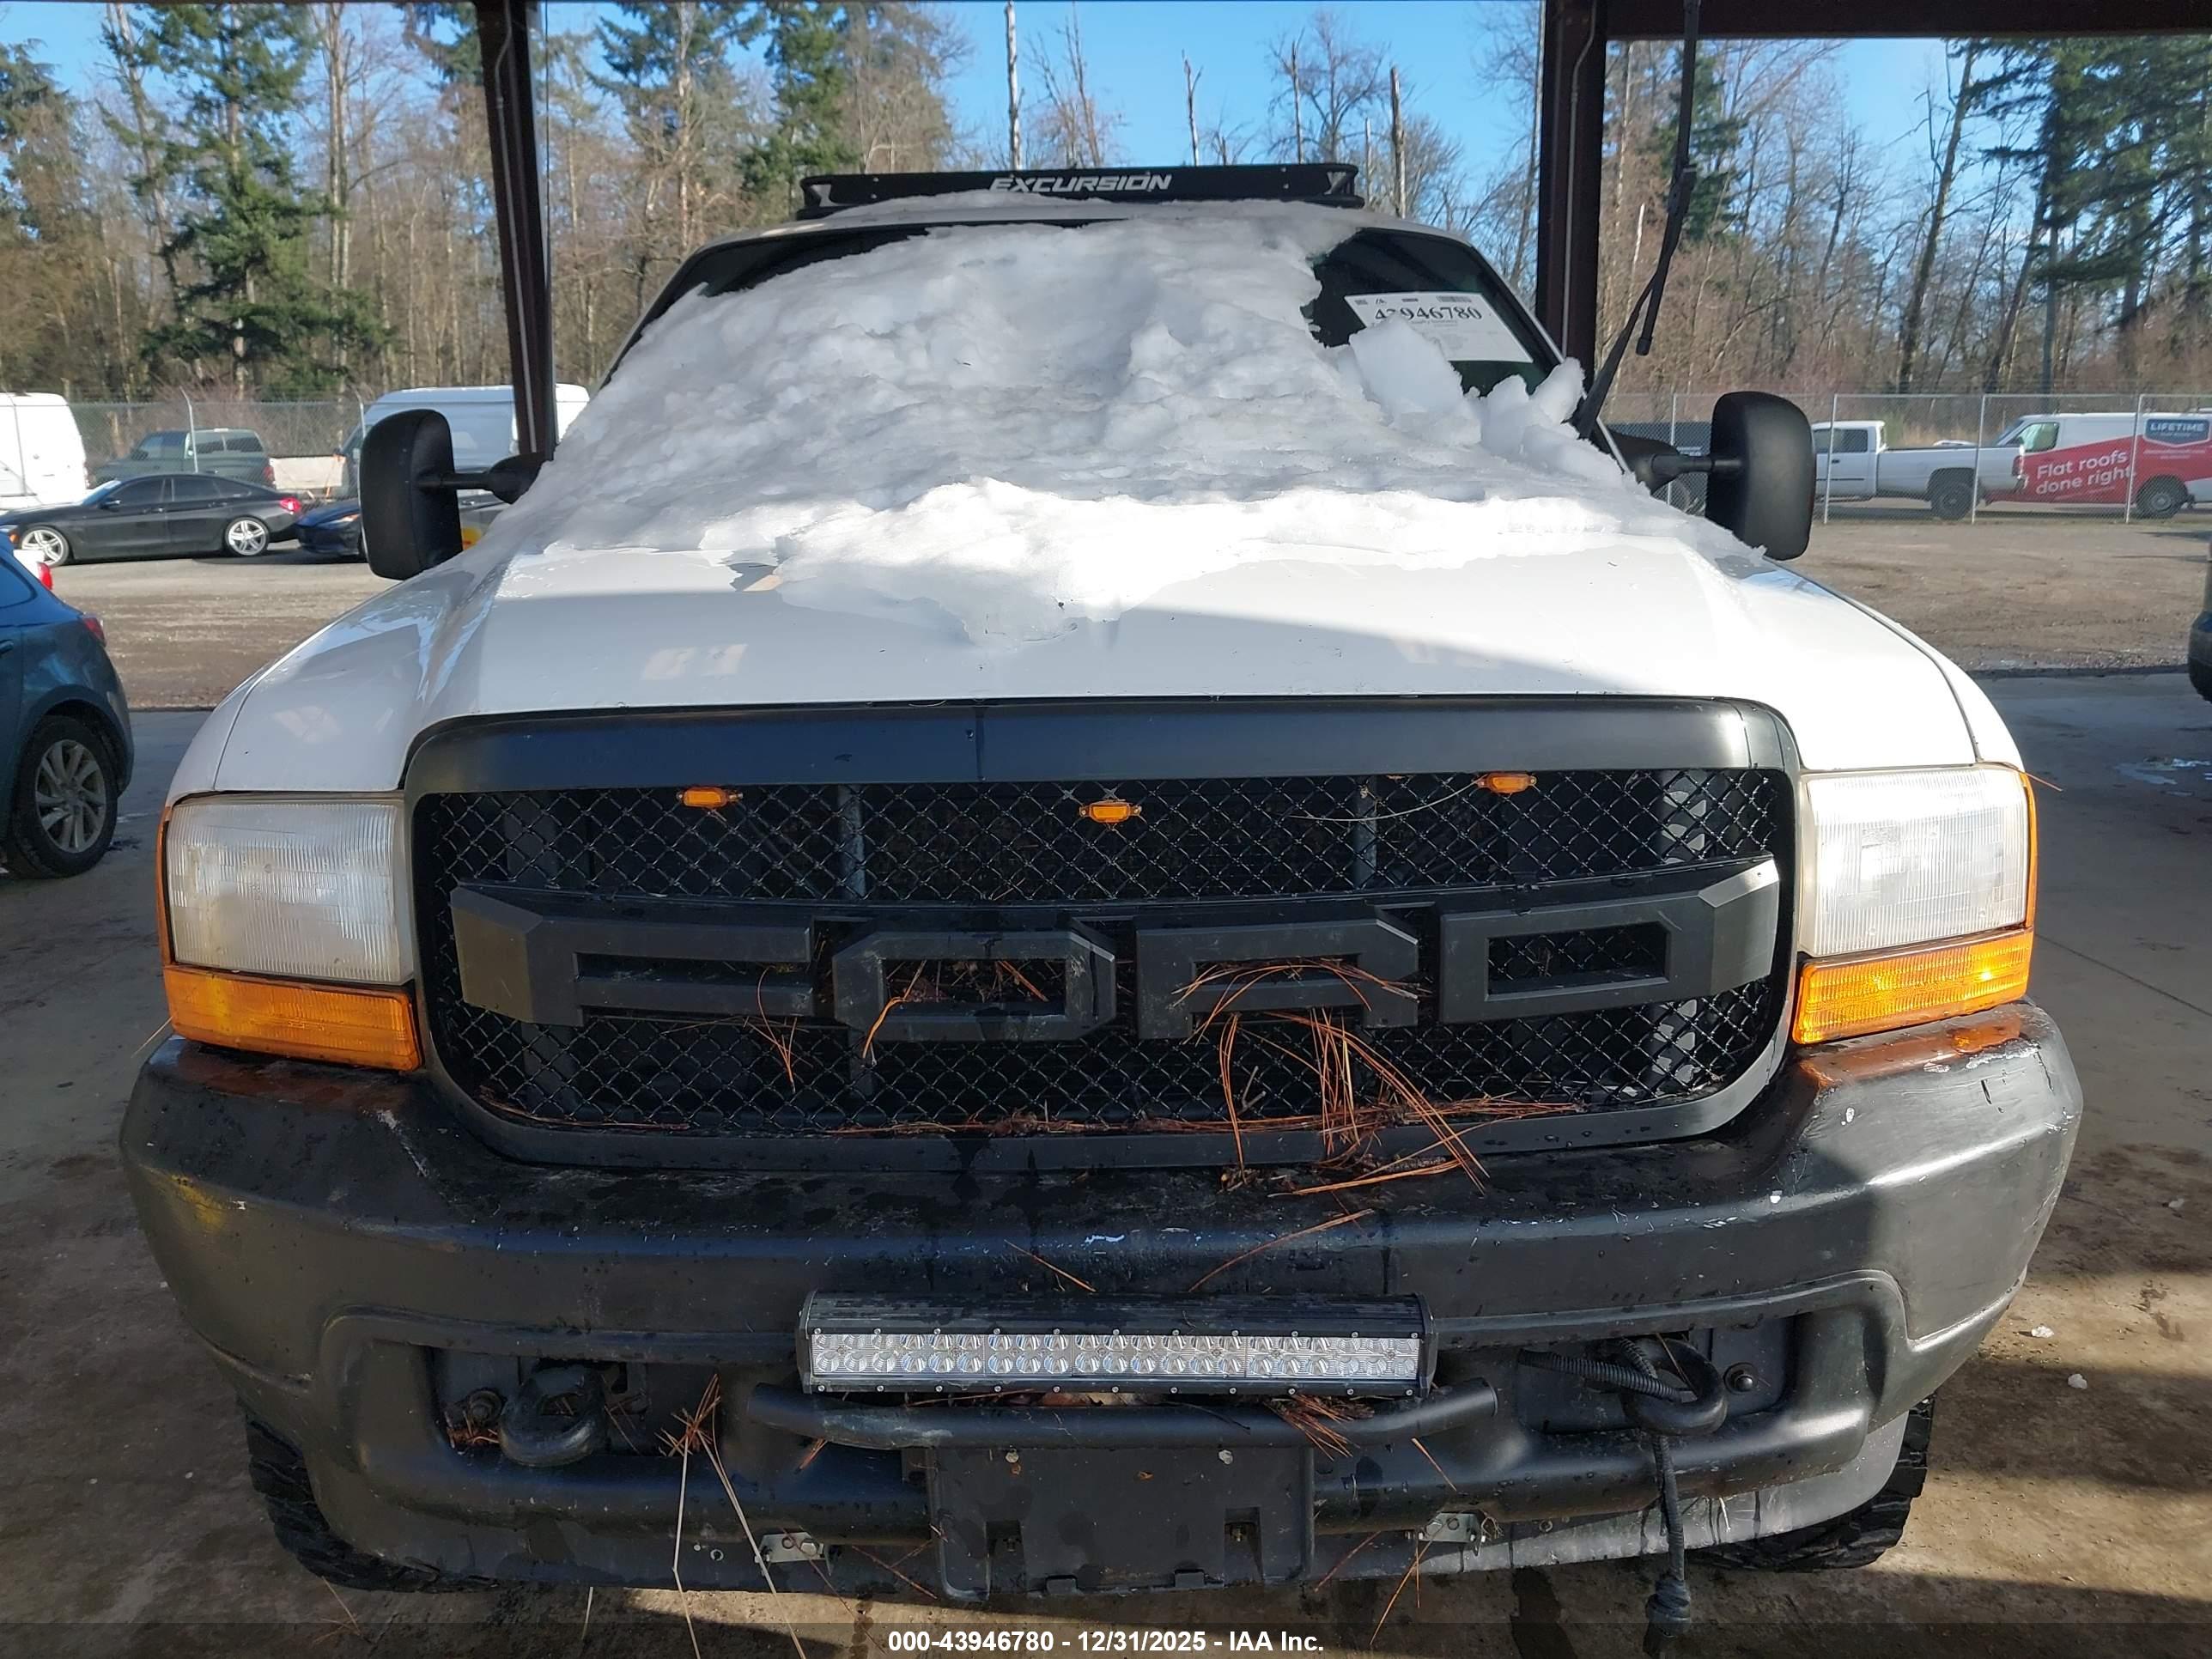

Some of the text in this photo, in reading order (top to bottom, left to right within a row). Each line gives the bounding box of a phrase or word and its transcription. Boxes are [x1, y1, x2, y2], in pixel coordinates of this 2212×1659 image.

[989, 174, 1172, 192] EXCURSION
[2149, 422, 2204, 431] LIFETIME
[2037, 450, 2128, 479] Flat roofs
[2036, 477, 2082, 495] done
[449, 857, 1781, 1042] FORD
